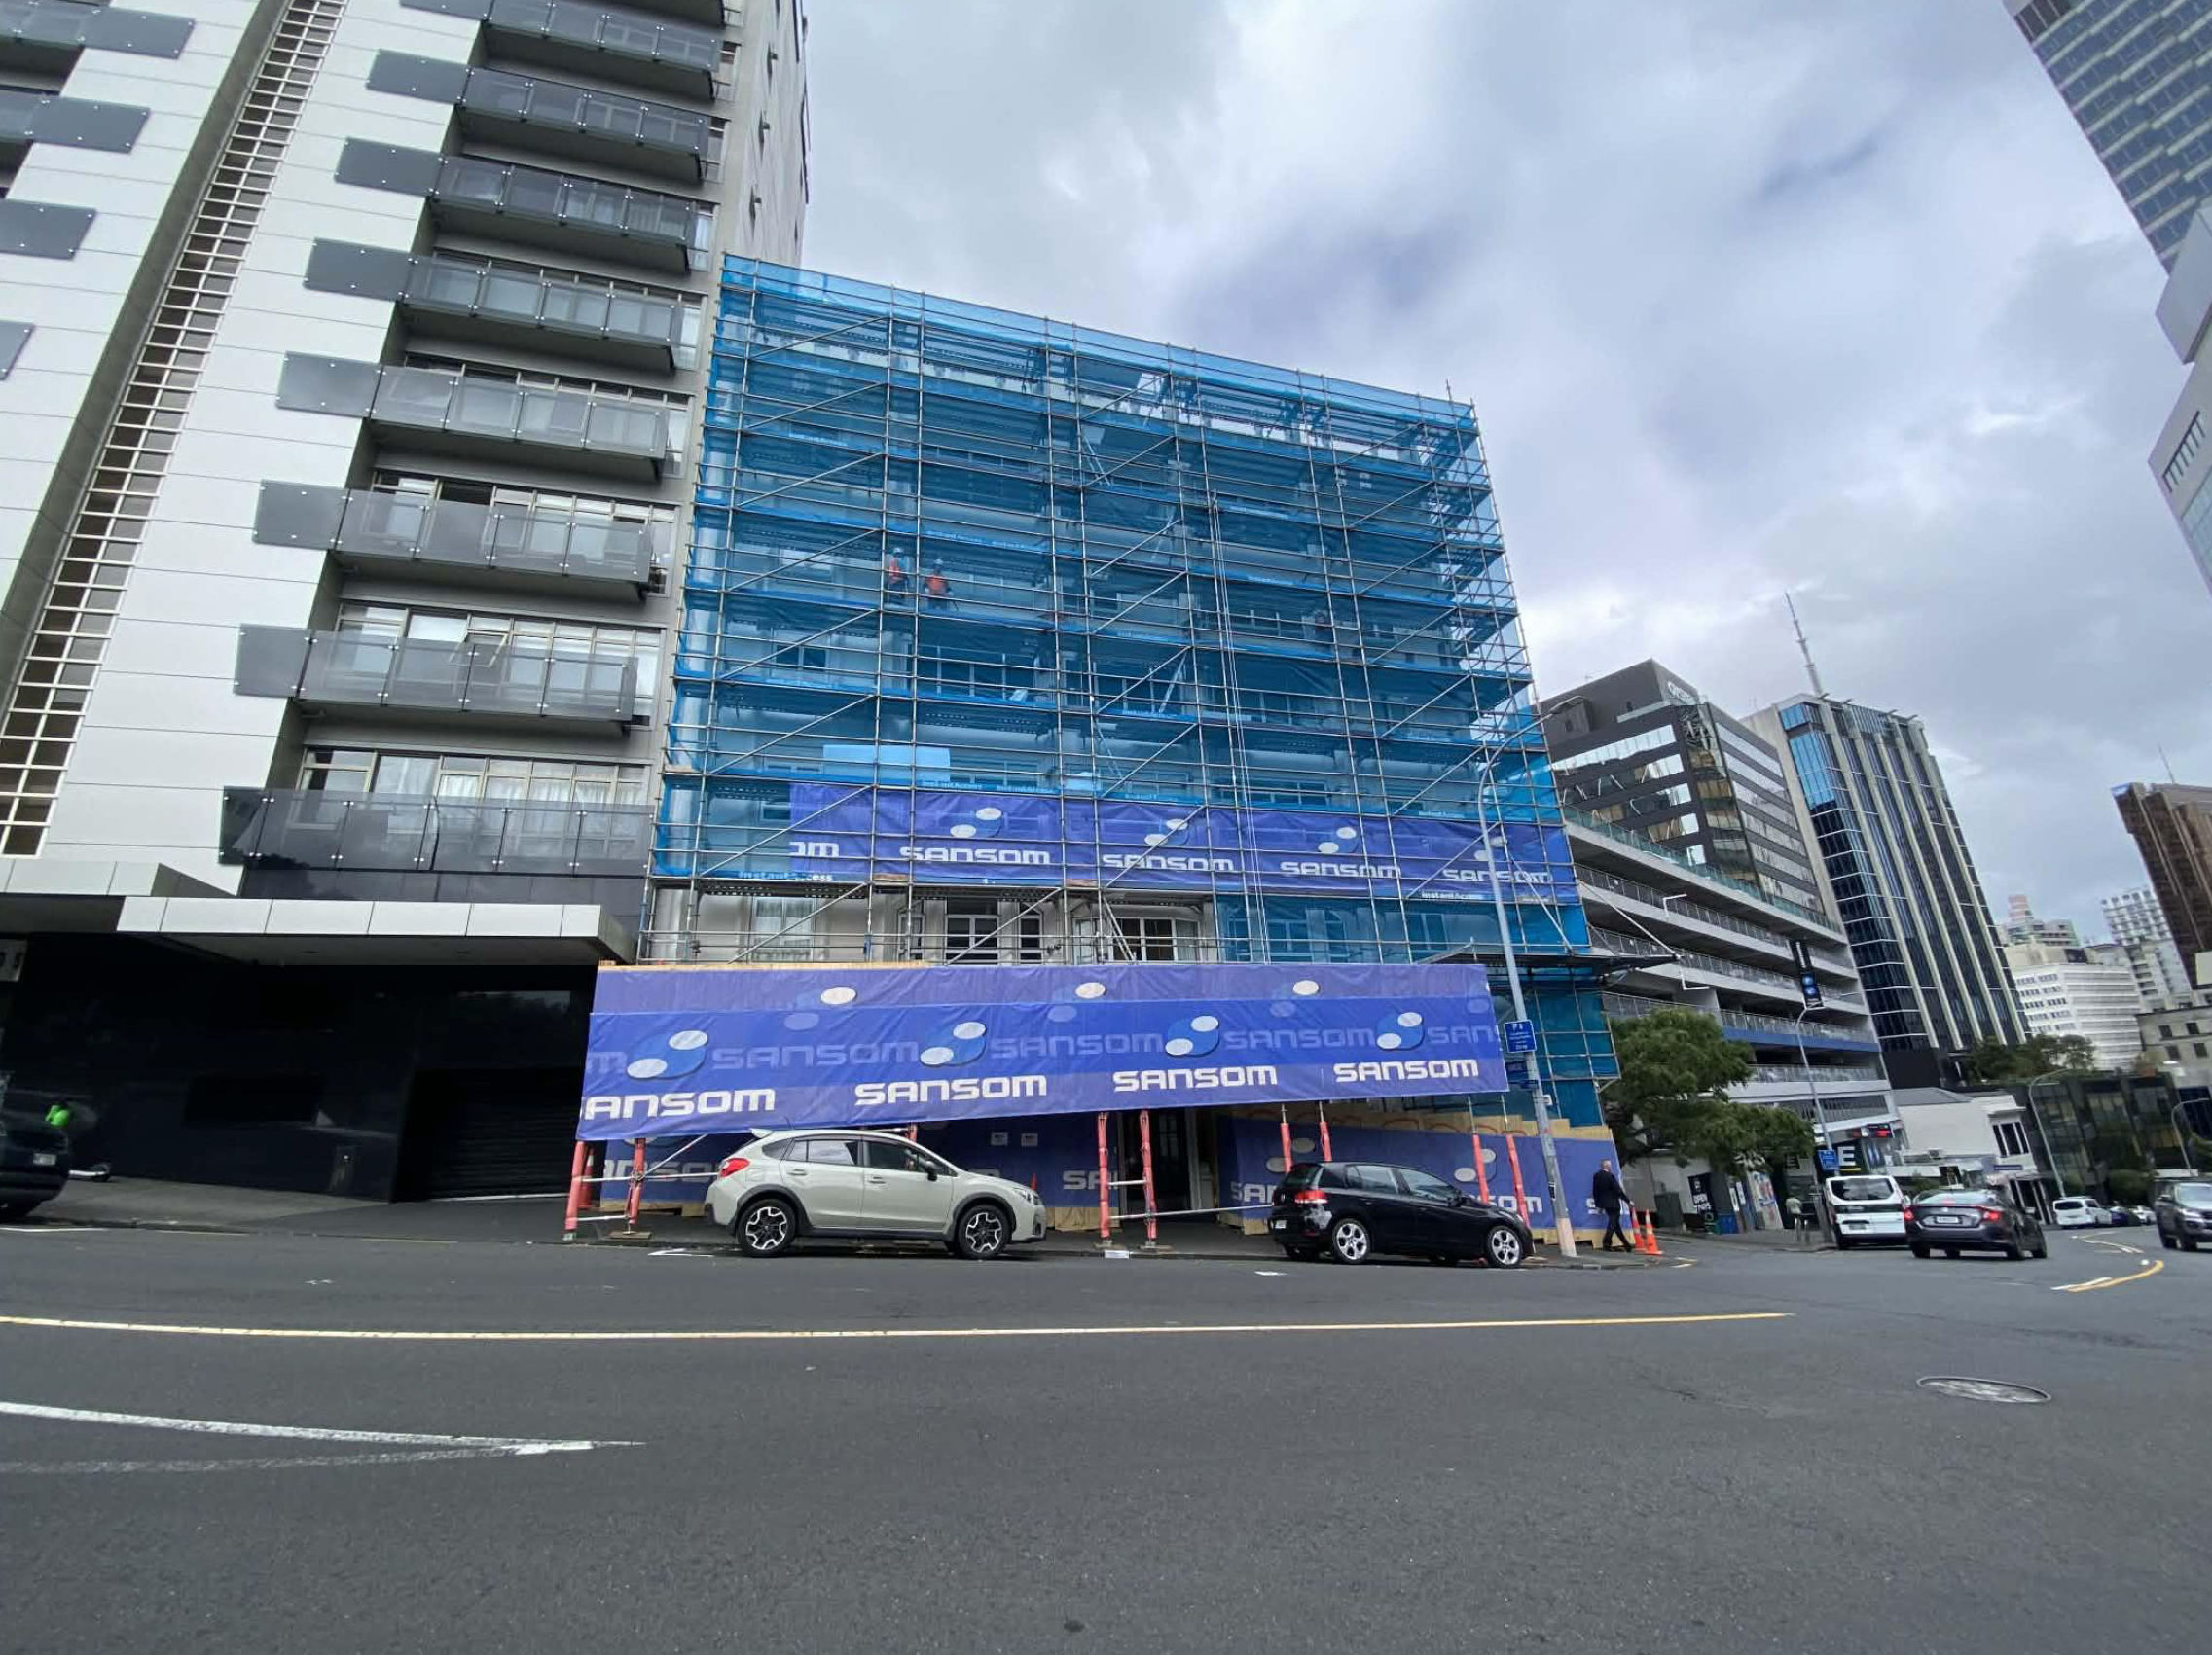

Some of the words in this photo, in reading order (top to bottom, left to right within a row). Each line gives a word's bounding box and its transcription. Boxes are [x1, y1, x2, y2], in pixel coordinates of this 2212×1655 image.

[899, 845, 1051, 865] SANSOM
[1102, 853, 1235, 871] SANSOM
[1280, 861, 1402, 879] SANSOM
[1112, 1066, 1279, 1092] SANSOM
[1332, 1059, 1479, 1083] SANSOM
[854, 1074, 1048, 1106] SANSOM
[581, 1088, 777, 1120] ANSOM
